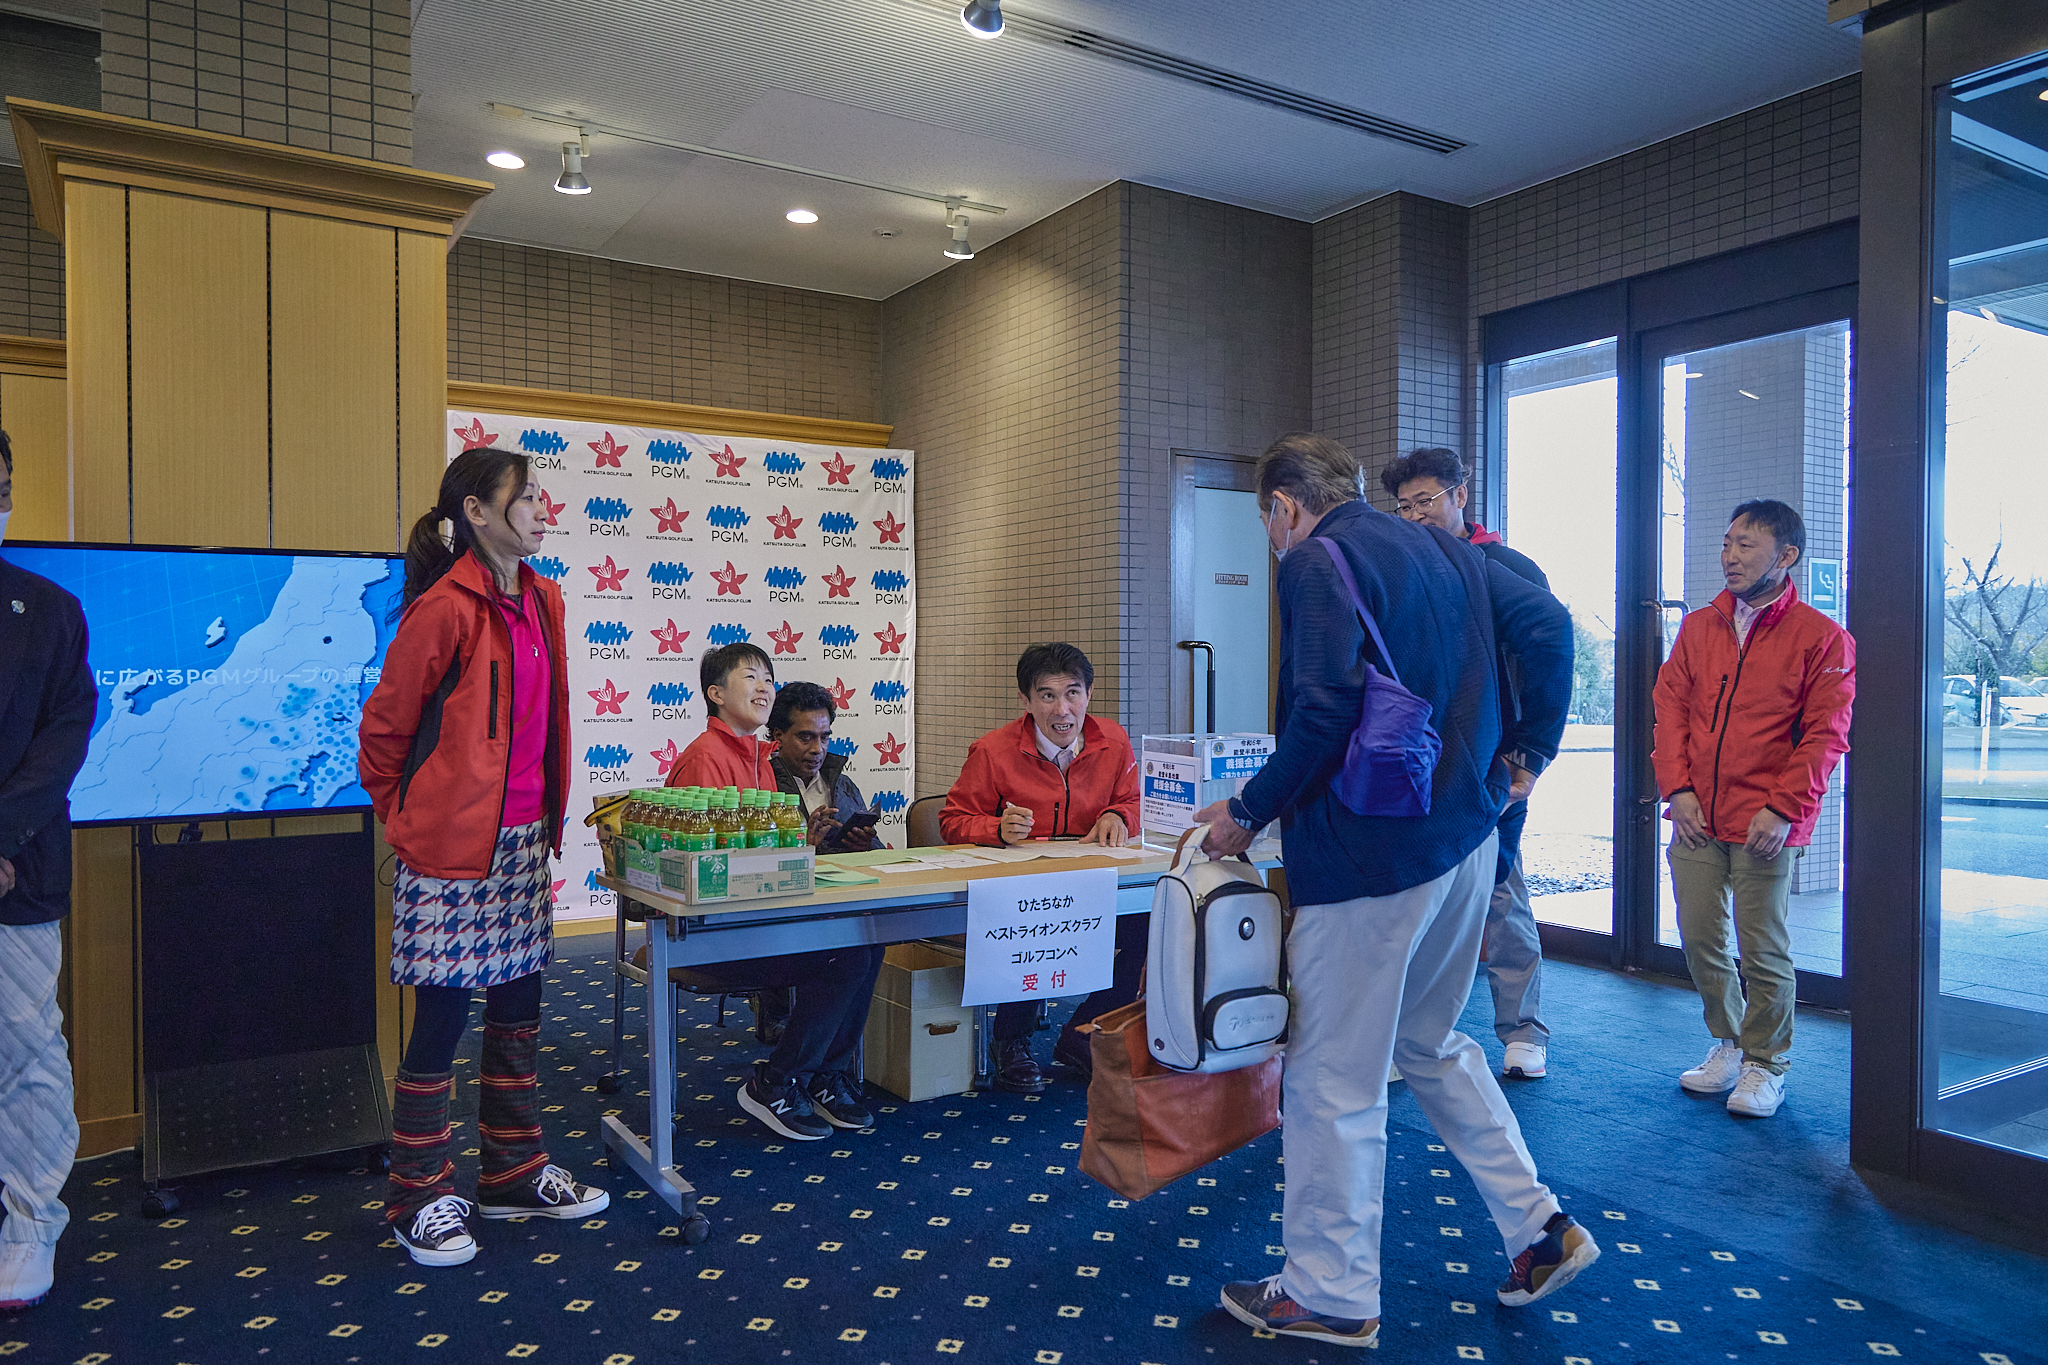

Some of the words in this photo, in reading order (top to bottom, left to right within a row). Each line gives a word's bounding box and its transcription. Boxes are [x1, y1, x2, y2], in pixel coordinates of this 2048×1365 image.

[652, 466, 686, 478] PGM
[768, 476, 798, 488] PGM
[874, 482, 902, 494] PGM
[590, 524, 624, 536] PGM
[712, 530, 744, 542] PGM
[824, 536, 852, 548] PGM
[652, 588, 686, 600] PGM
[770, 590, 800, 602] PGM
[876, 594, 904, 604] PGM
[590, 648, 624, 660] PGM
[824, 648, 852, 660] PGM
[96, 667, 381, 686] に広がるPGMグループの運営
[652, 708, 686, 720] PGM
[874, 704, 902, 714] PGM
[590, 770, 624, 784] PGM
[874, 814, 902, 826] PGM
[1018, 895, 1074, 912] ひたちなか
[985, 916, 1102, 940] ベストライオンズクラブ
[1011, 946, 1078, 964] ゴルフコンペ
[1022, 970, 1066, 992] 受付
[815, 1088, 836, 1104] N
[770, 1098, 792, 1116] N
